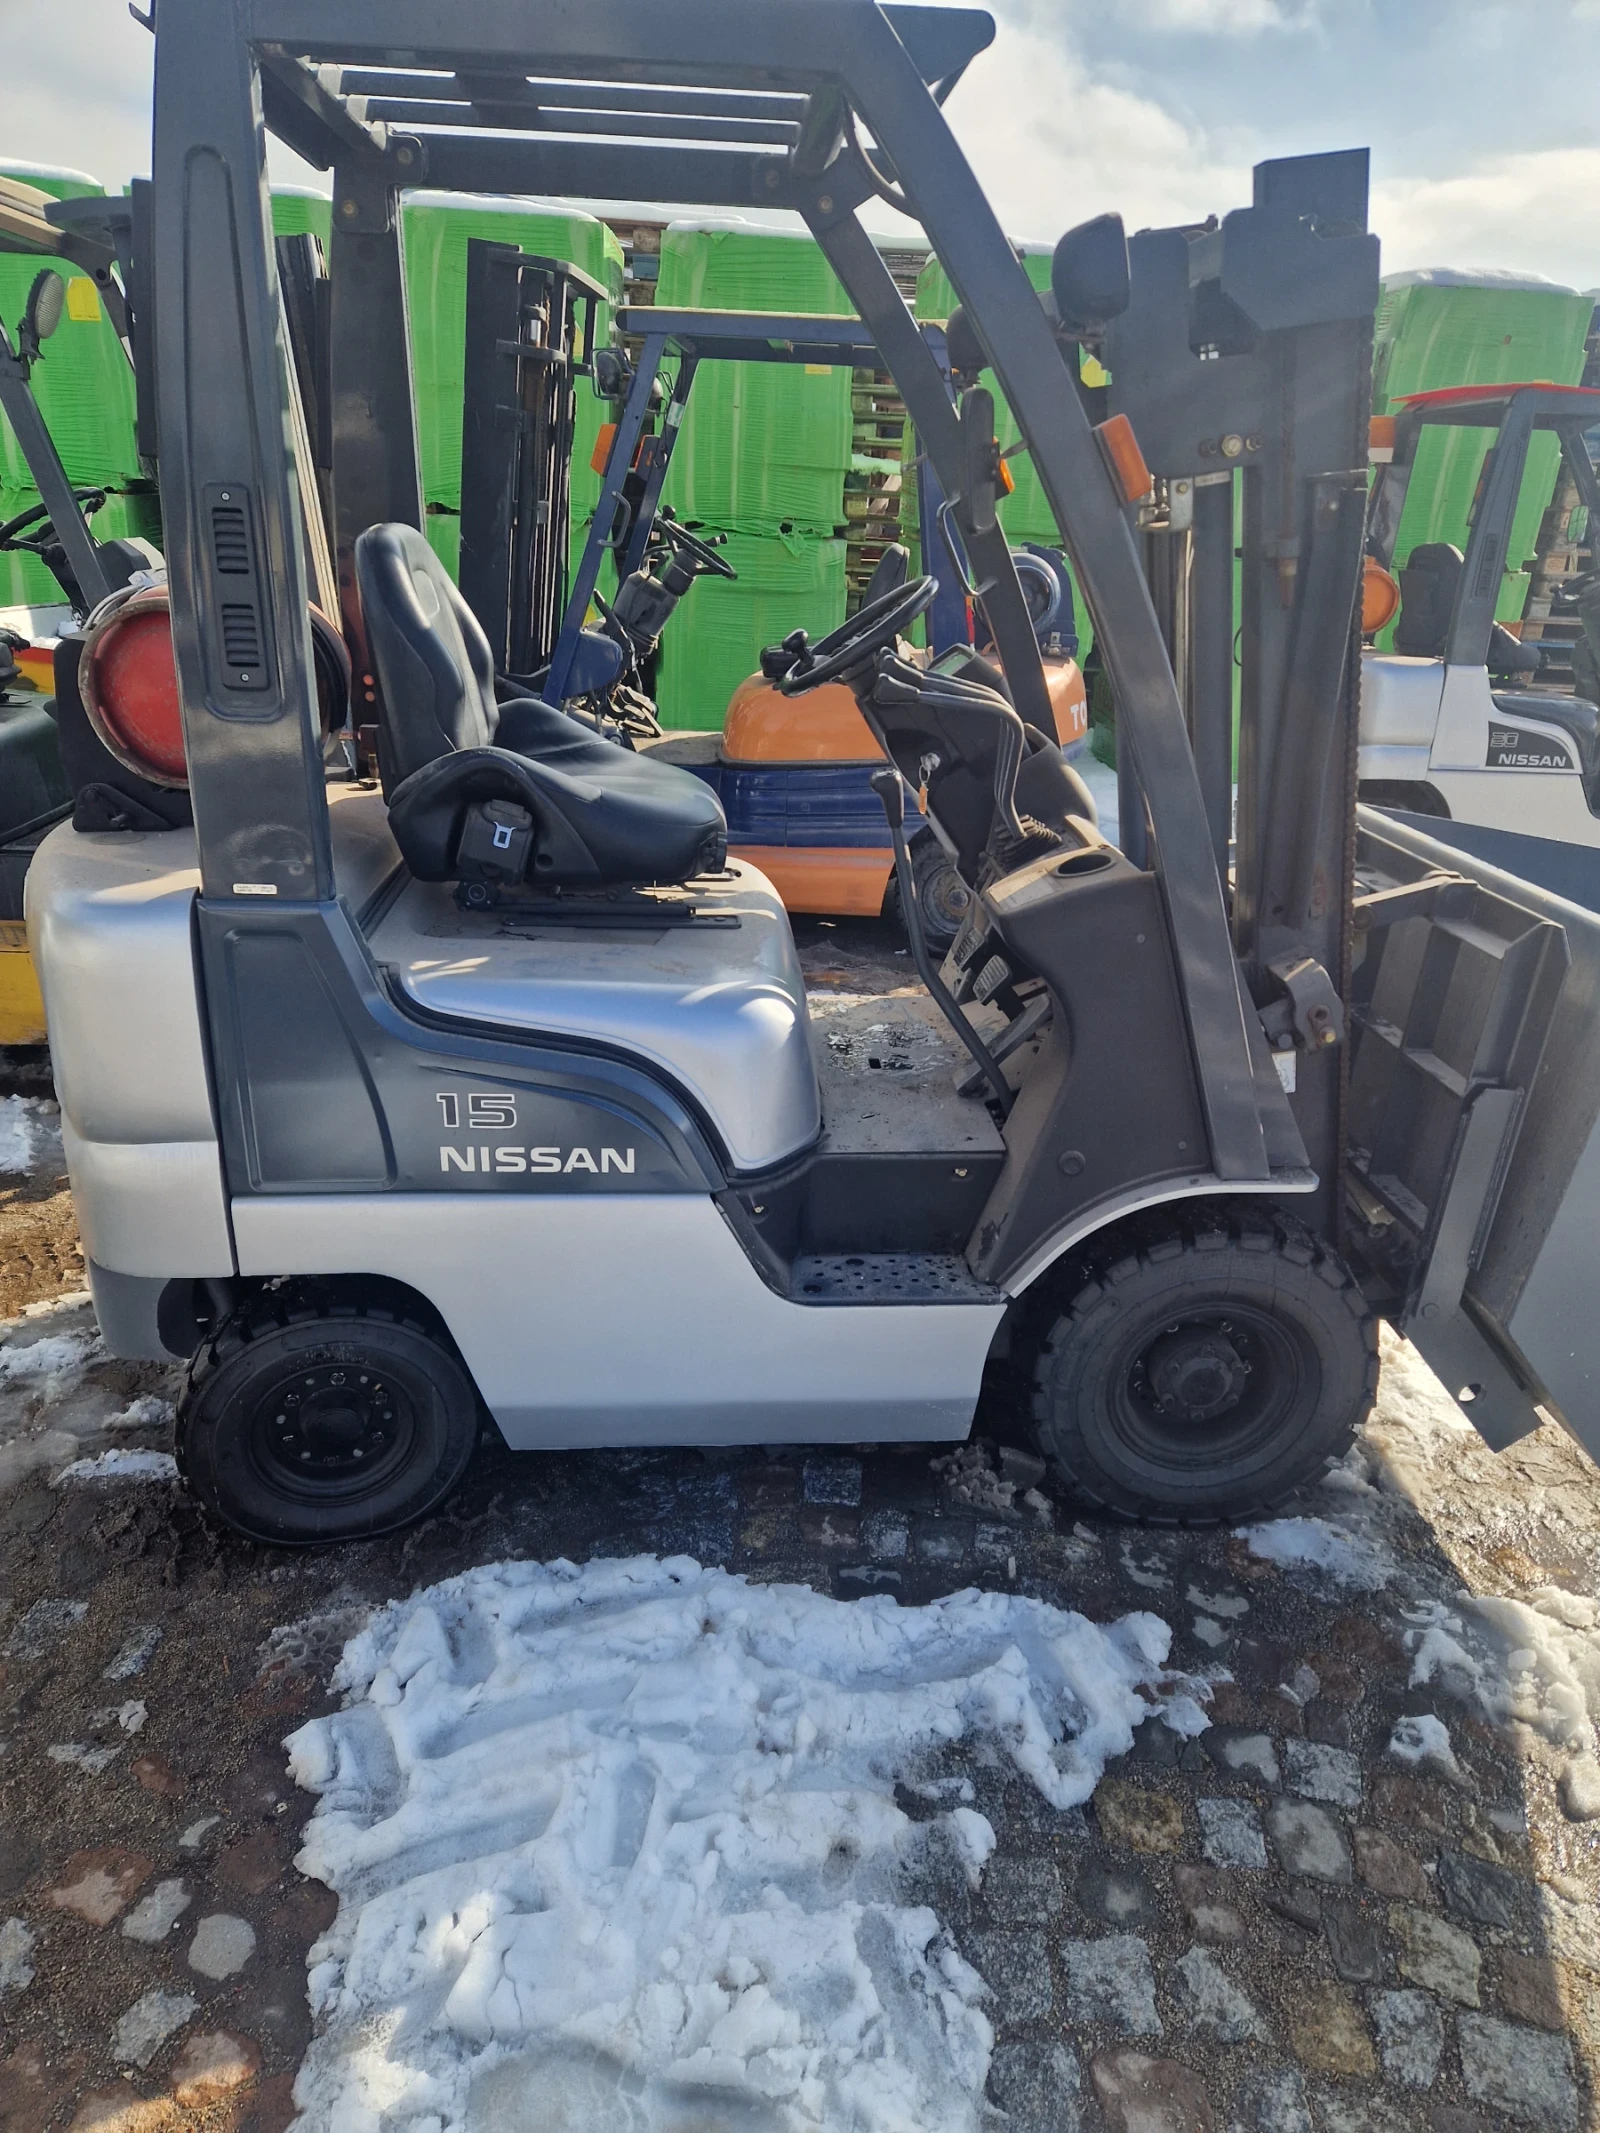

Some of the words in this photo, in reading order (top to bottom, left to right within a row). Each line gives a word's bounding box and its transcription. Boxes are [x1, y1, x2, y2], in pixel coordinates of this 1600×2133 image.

[1490, 732, 1519, 748] 20
[1498, 753, 1566, 767] NISSAN
[436, 1092, 517, 1129] 15
[439, 1146, 635, 1174] NISSAN
